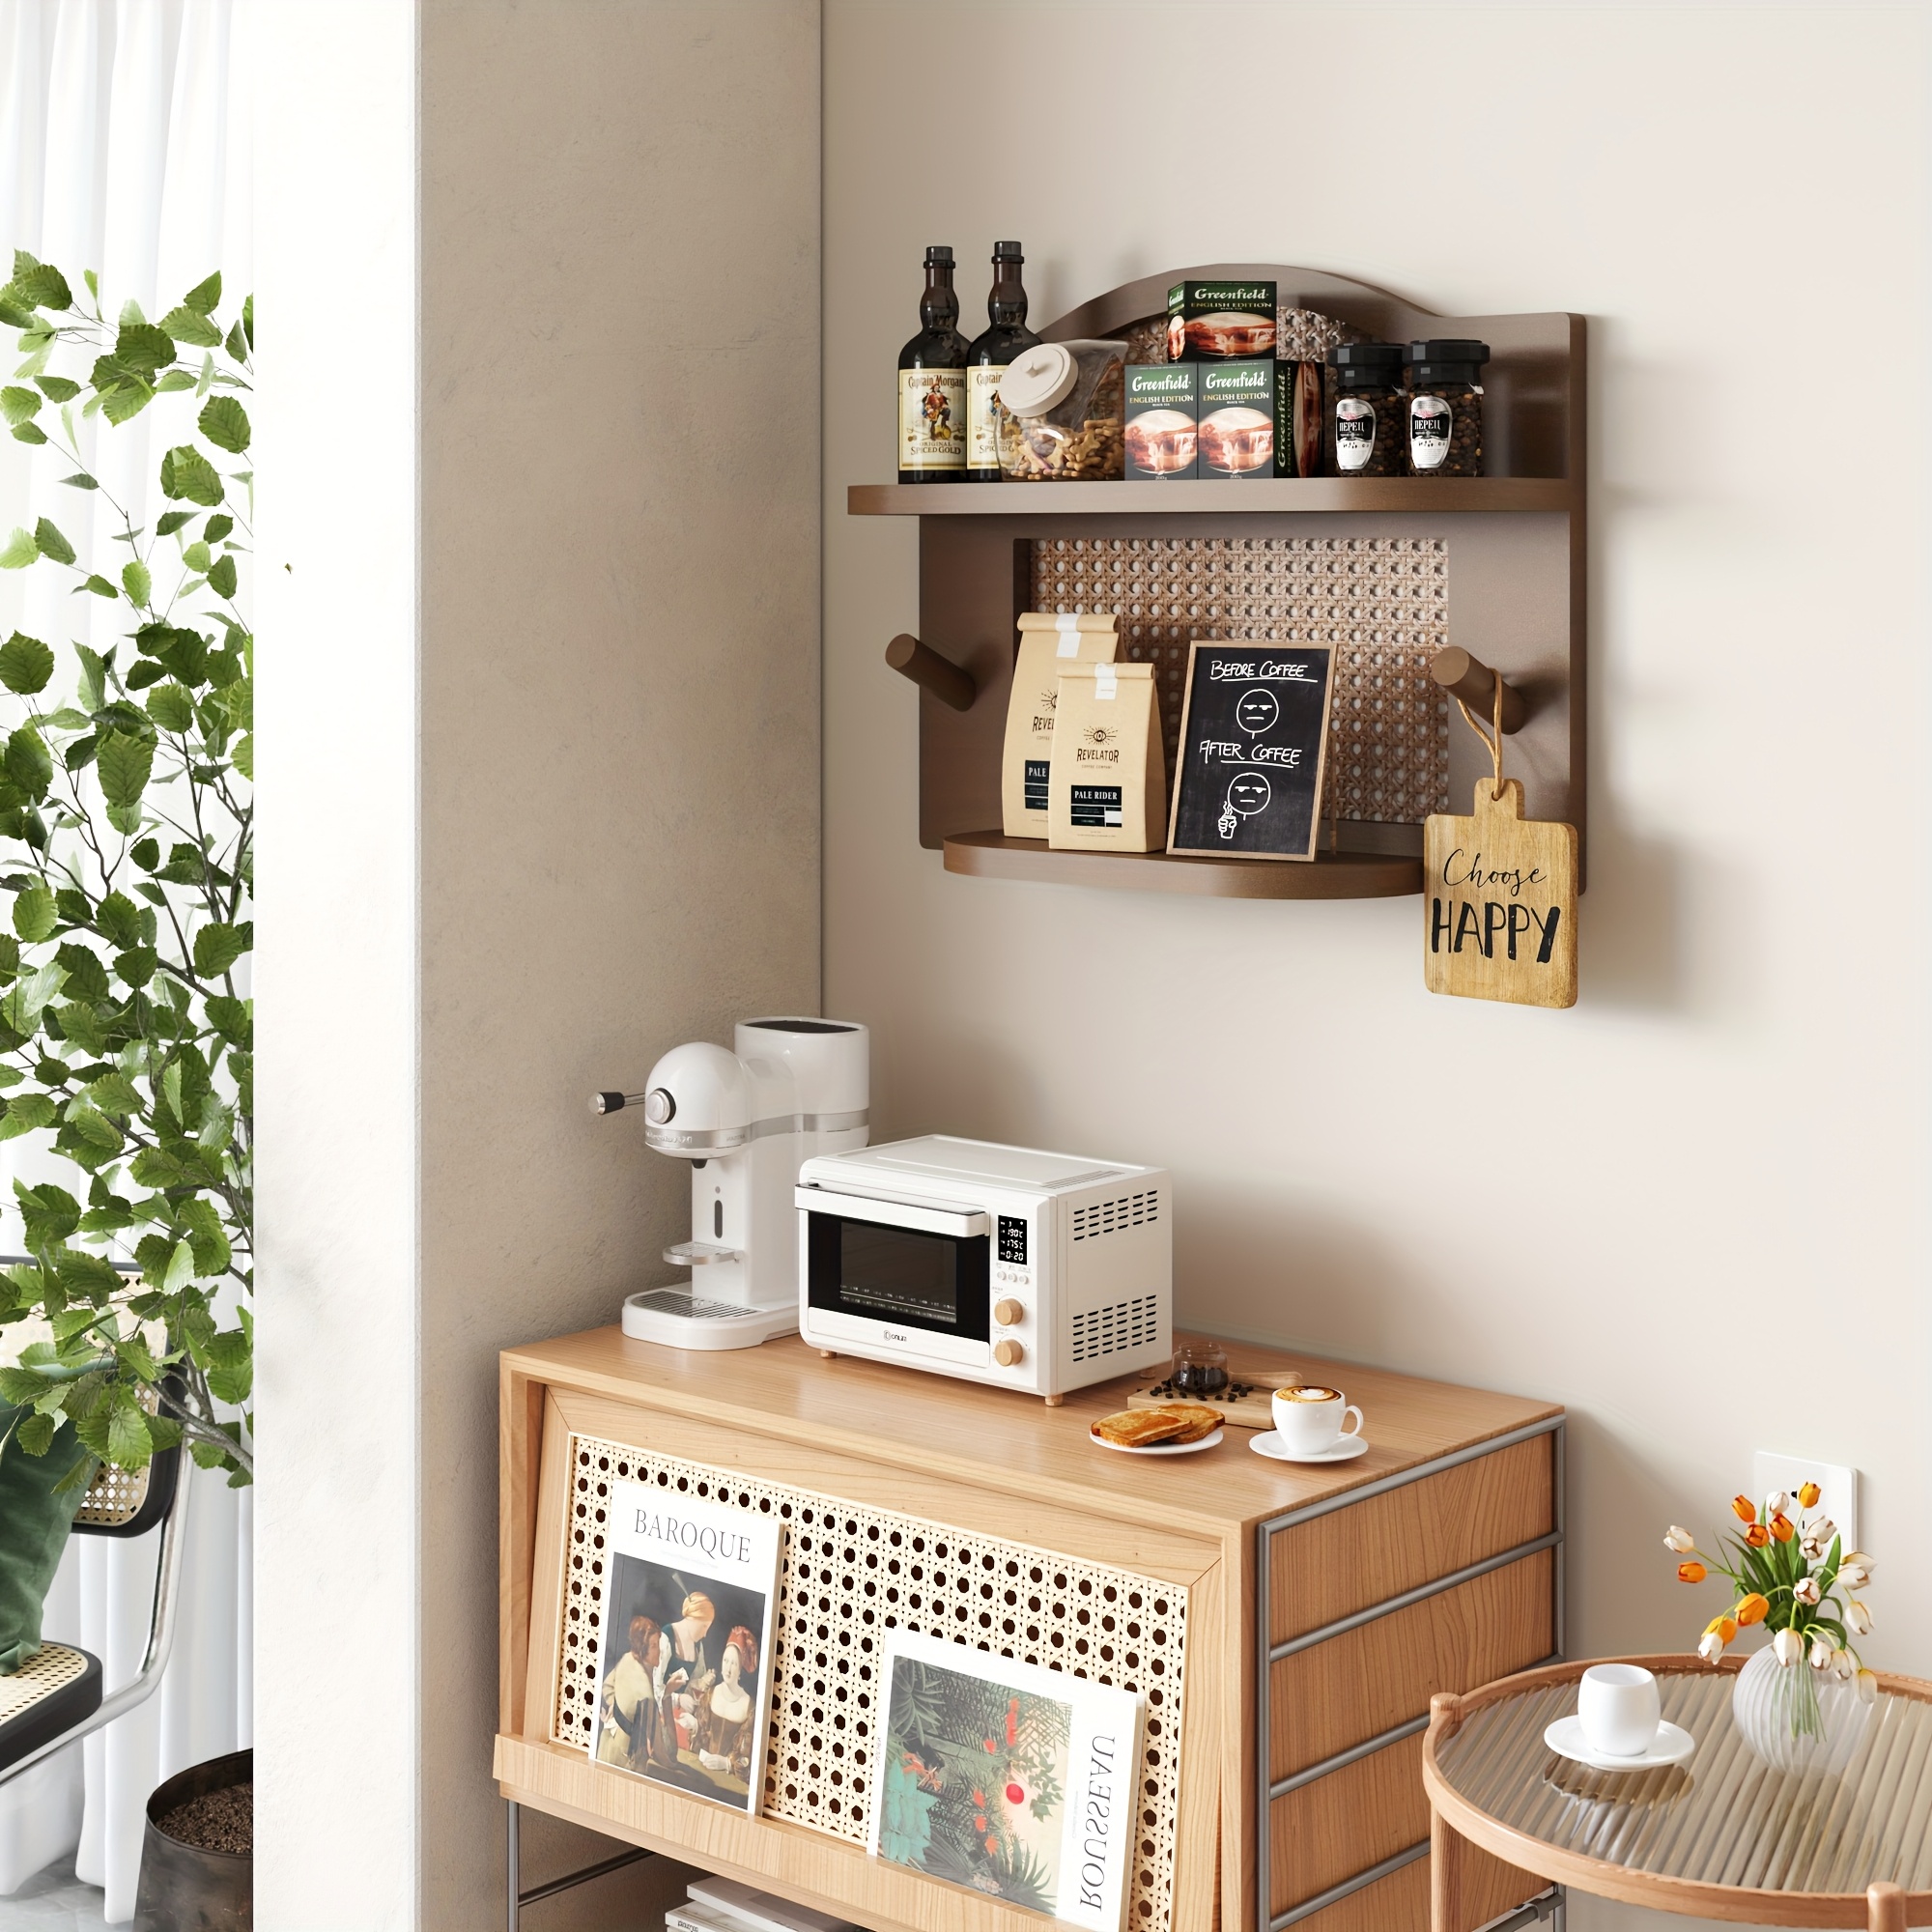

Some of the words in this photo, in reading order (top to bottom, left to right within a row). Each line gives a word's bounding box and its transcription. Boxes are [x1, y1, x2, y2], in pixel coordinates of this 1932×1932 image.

[1194, 288, 1266, 299] Greenfield
[908, 375, 933, 388] Captain
[934, 375, 964, 388] Morgan
[1132, 373, 1189, 392] Greenfield
[1206, 371, 1265, 389] Greenfield
[1161, 394, 1194, 403] EDITION
[1236, 391, 1269, 400] EDITION
[1339, 421, 1364, 433] ПЕРЕЦ
[1414, 419, 1441, 431] ПЕРЕЦ
[911, 446, 937, 455] SPICED
[939, 446, 961, 455] GOLD
[1209, 661, 1256, 680] BEFORE
[1259, 661, 1308, 678] COFFEE
[1076, 748, 1120, 763] REVELATOR
[1199, 739, 1245, 764] AFTER
[1251, 744, 1302, 765] COFFEE
[1028, 767, 1047, 777] PALE
[1074, 790, 1093, 799] PALE
[1094, 791, 1118, 800] RIDER
[1443, 848, 1548, 896] Choose
[1432, 897, 1561, 964] HAPPY
[1006, 1250, 1024, 1262] 0:20
[634, 1509, 751, 1563] BAROQUE
